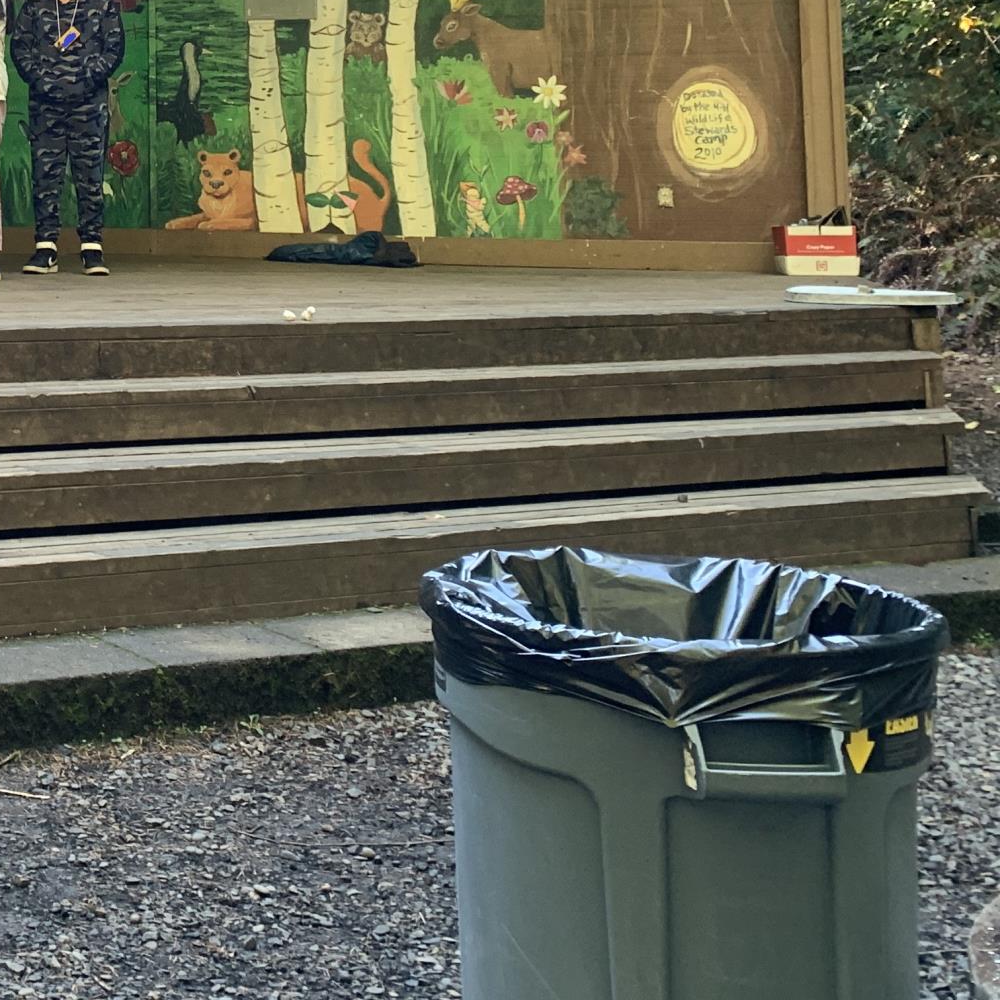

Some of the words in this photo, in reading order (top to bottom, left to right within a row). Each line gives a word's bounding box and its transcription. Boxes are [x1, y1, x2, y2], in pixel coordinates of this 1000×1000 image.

[684, 124, 738, 136] Stewards
[695, 134, 728, 147] Camp
[694, 147, 722, 160] 2010
